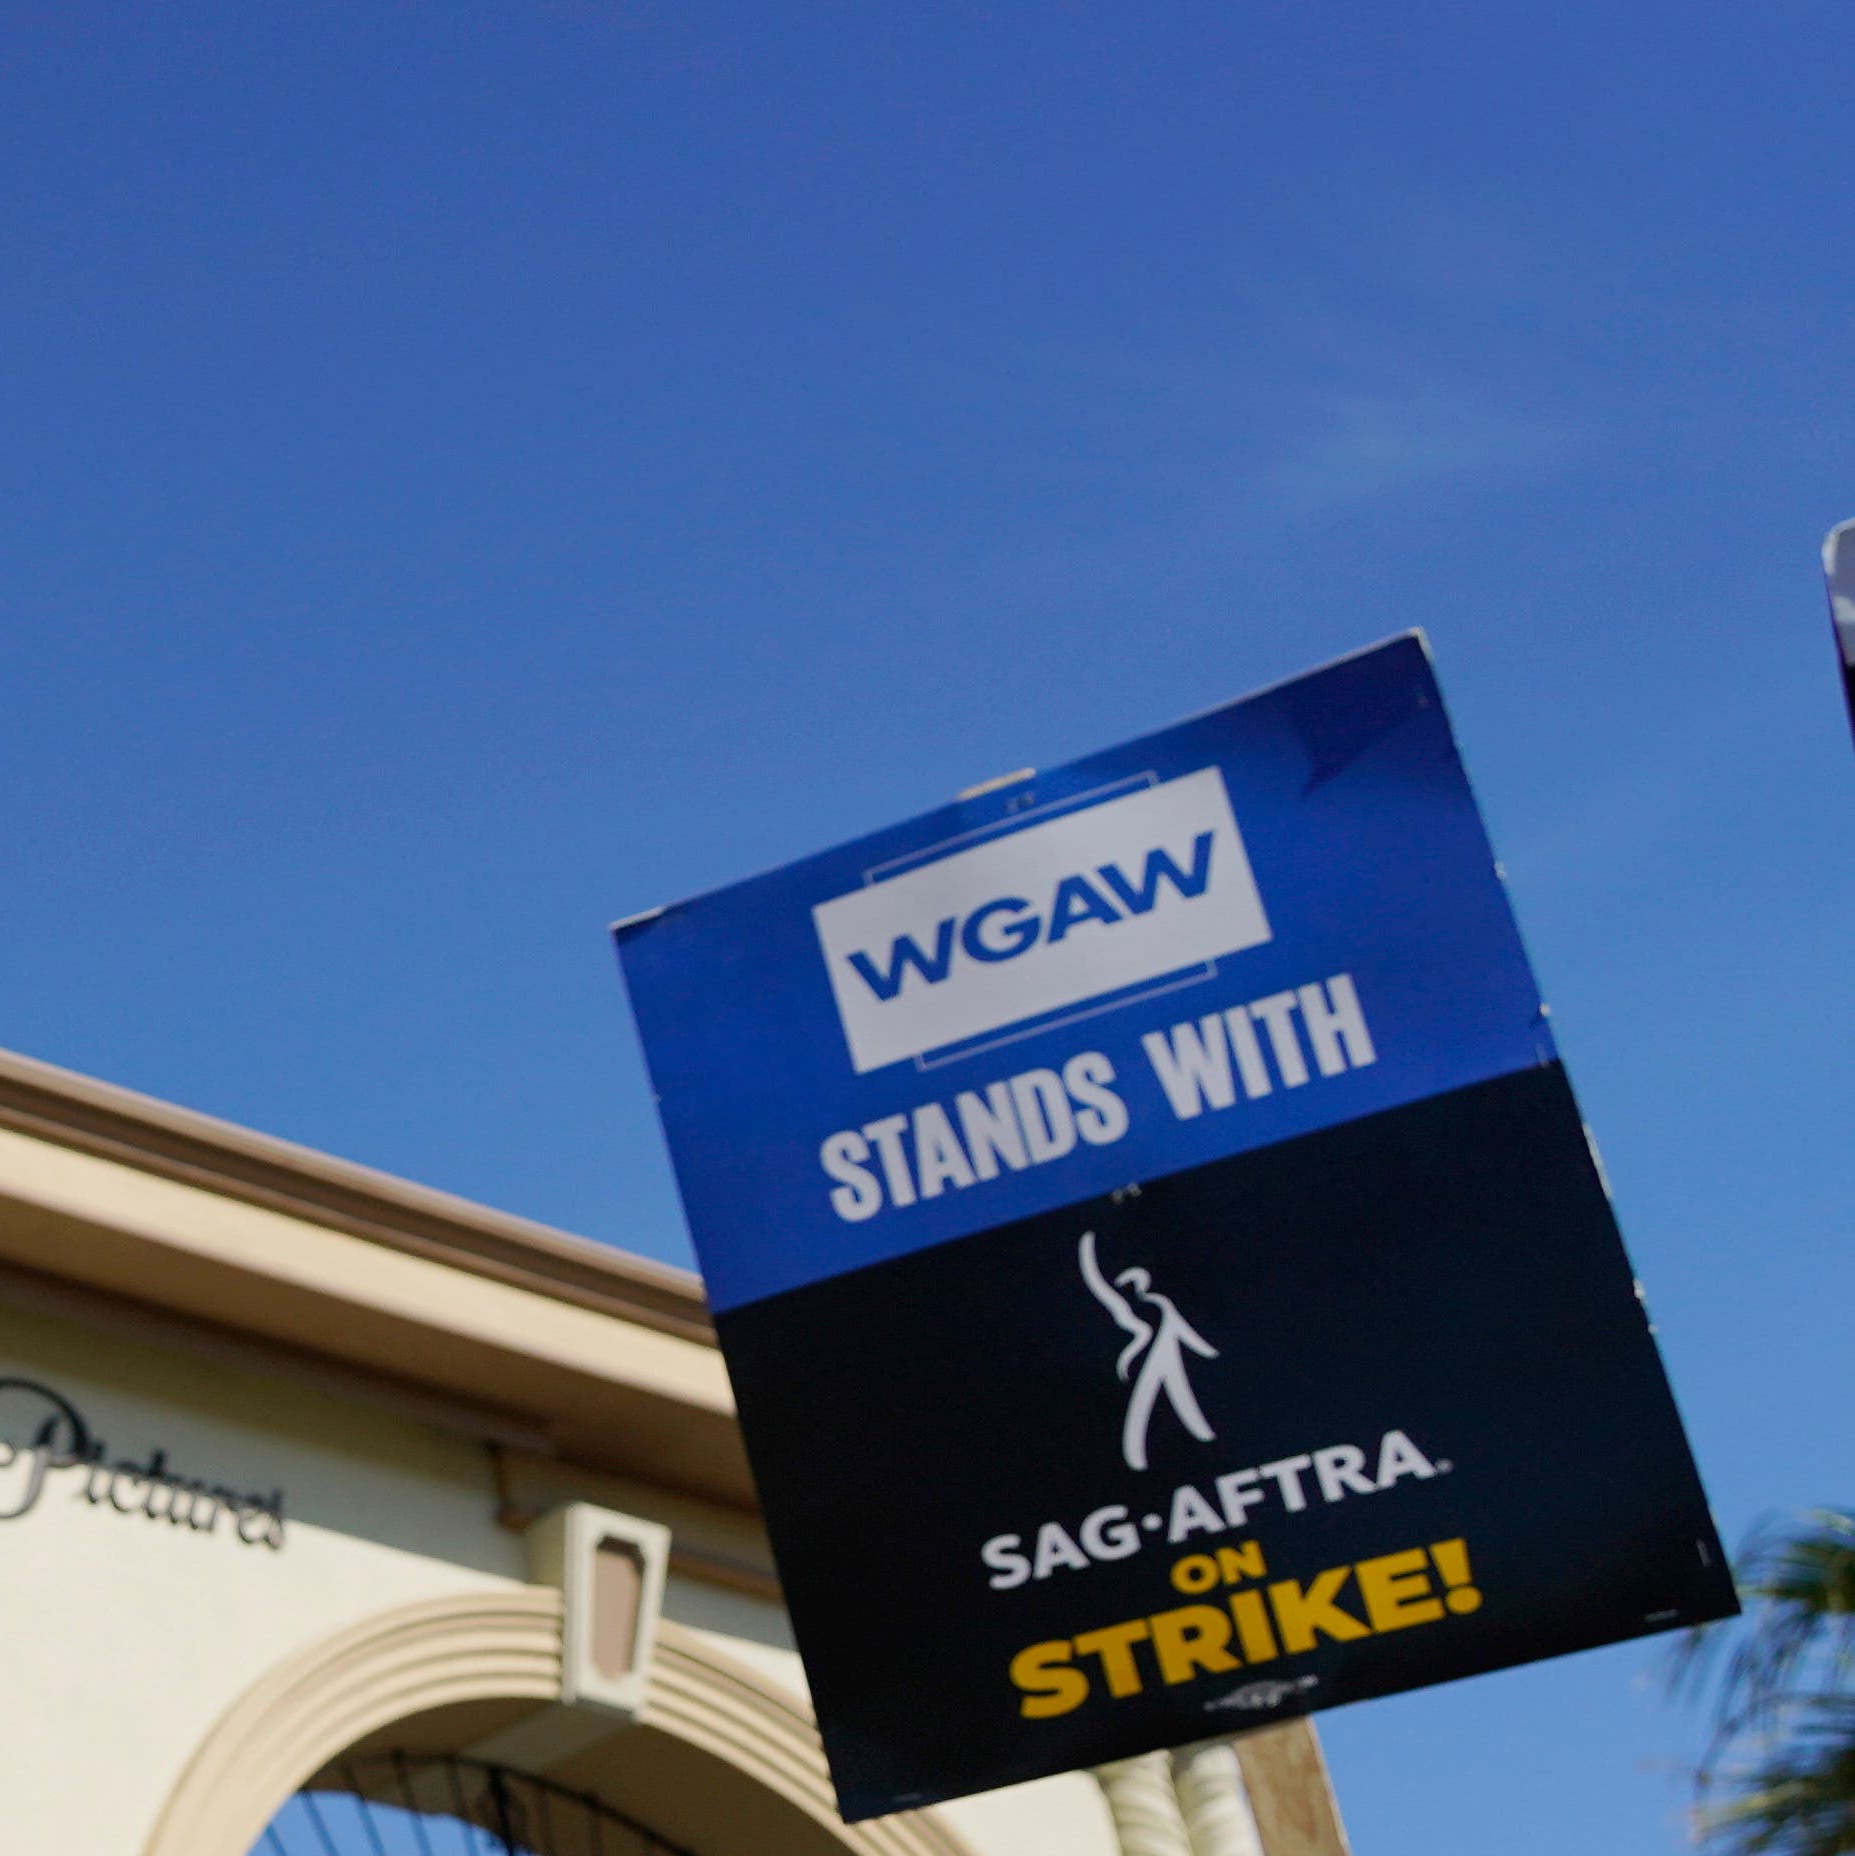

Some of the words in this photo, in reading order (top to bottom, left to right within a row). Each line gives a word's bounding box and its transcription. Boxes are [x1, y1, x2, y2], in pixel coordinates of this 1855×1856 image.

[845, 829, 1216, 1002] WGAW
[820, 1051, 1128, 1223] STANDS
[1142, 973, 1376, 1120] WITH
[1009, 1537, 1484, 1719] STRIKE!
[1170, 1540, 1266, 1588] ON
